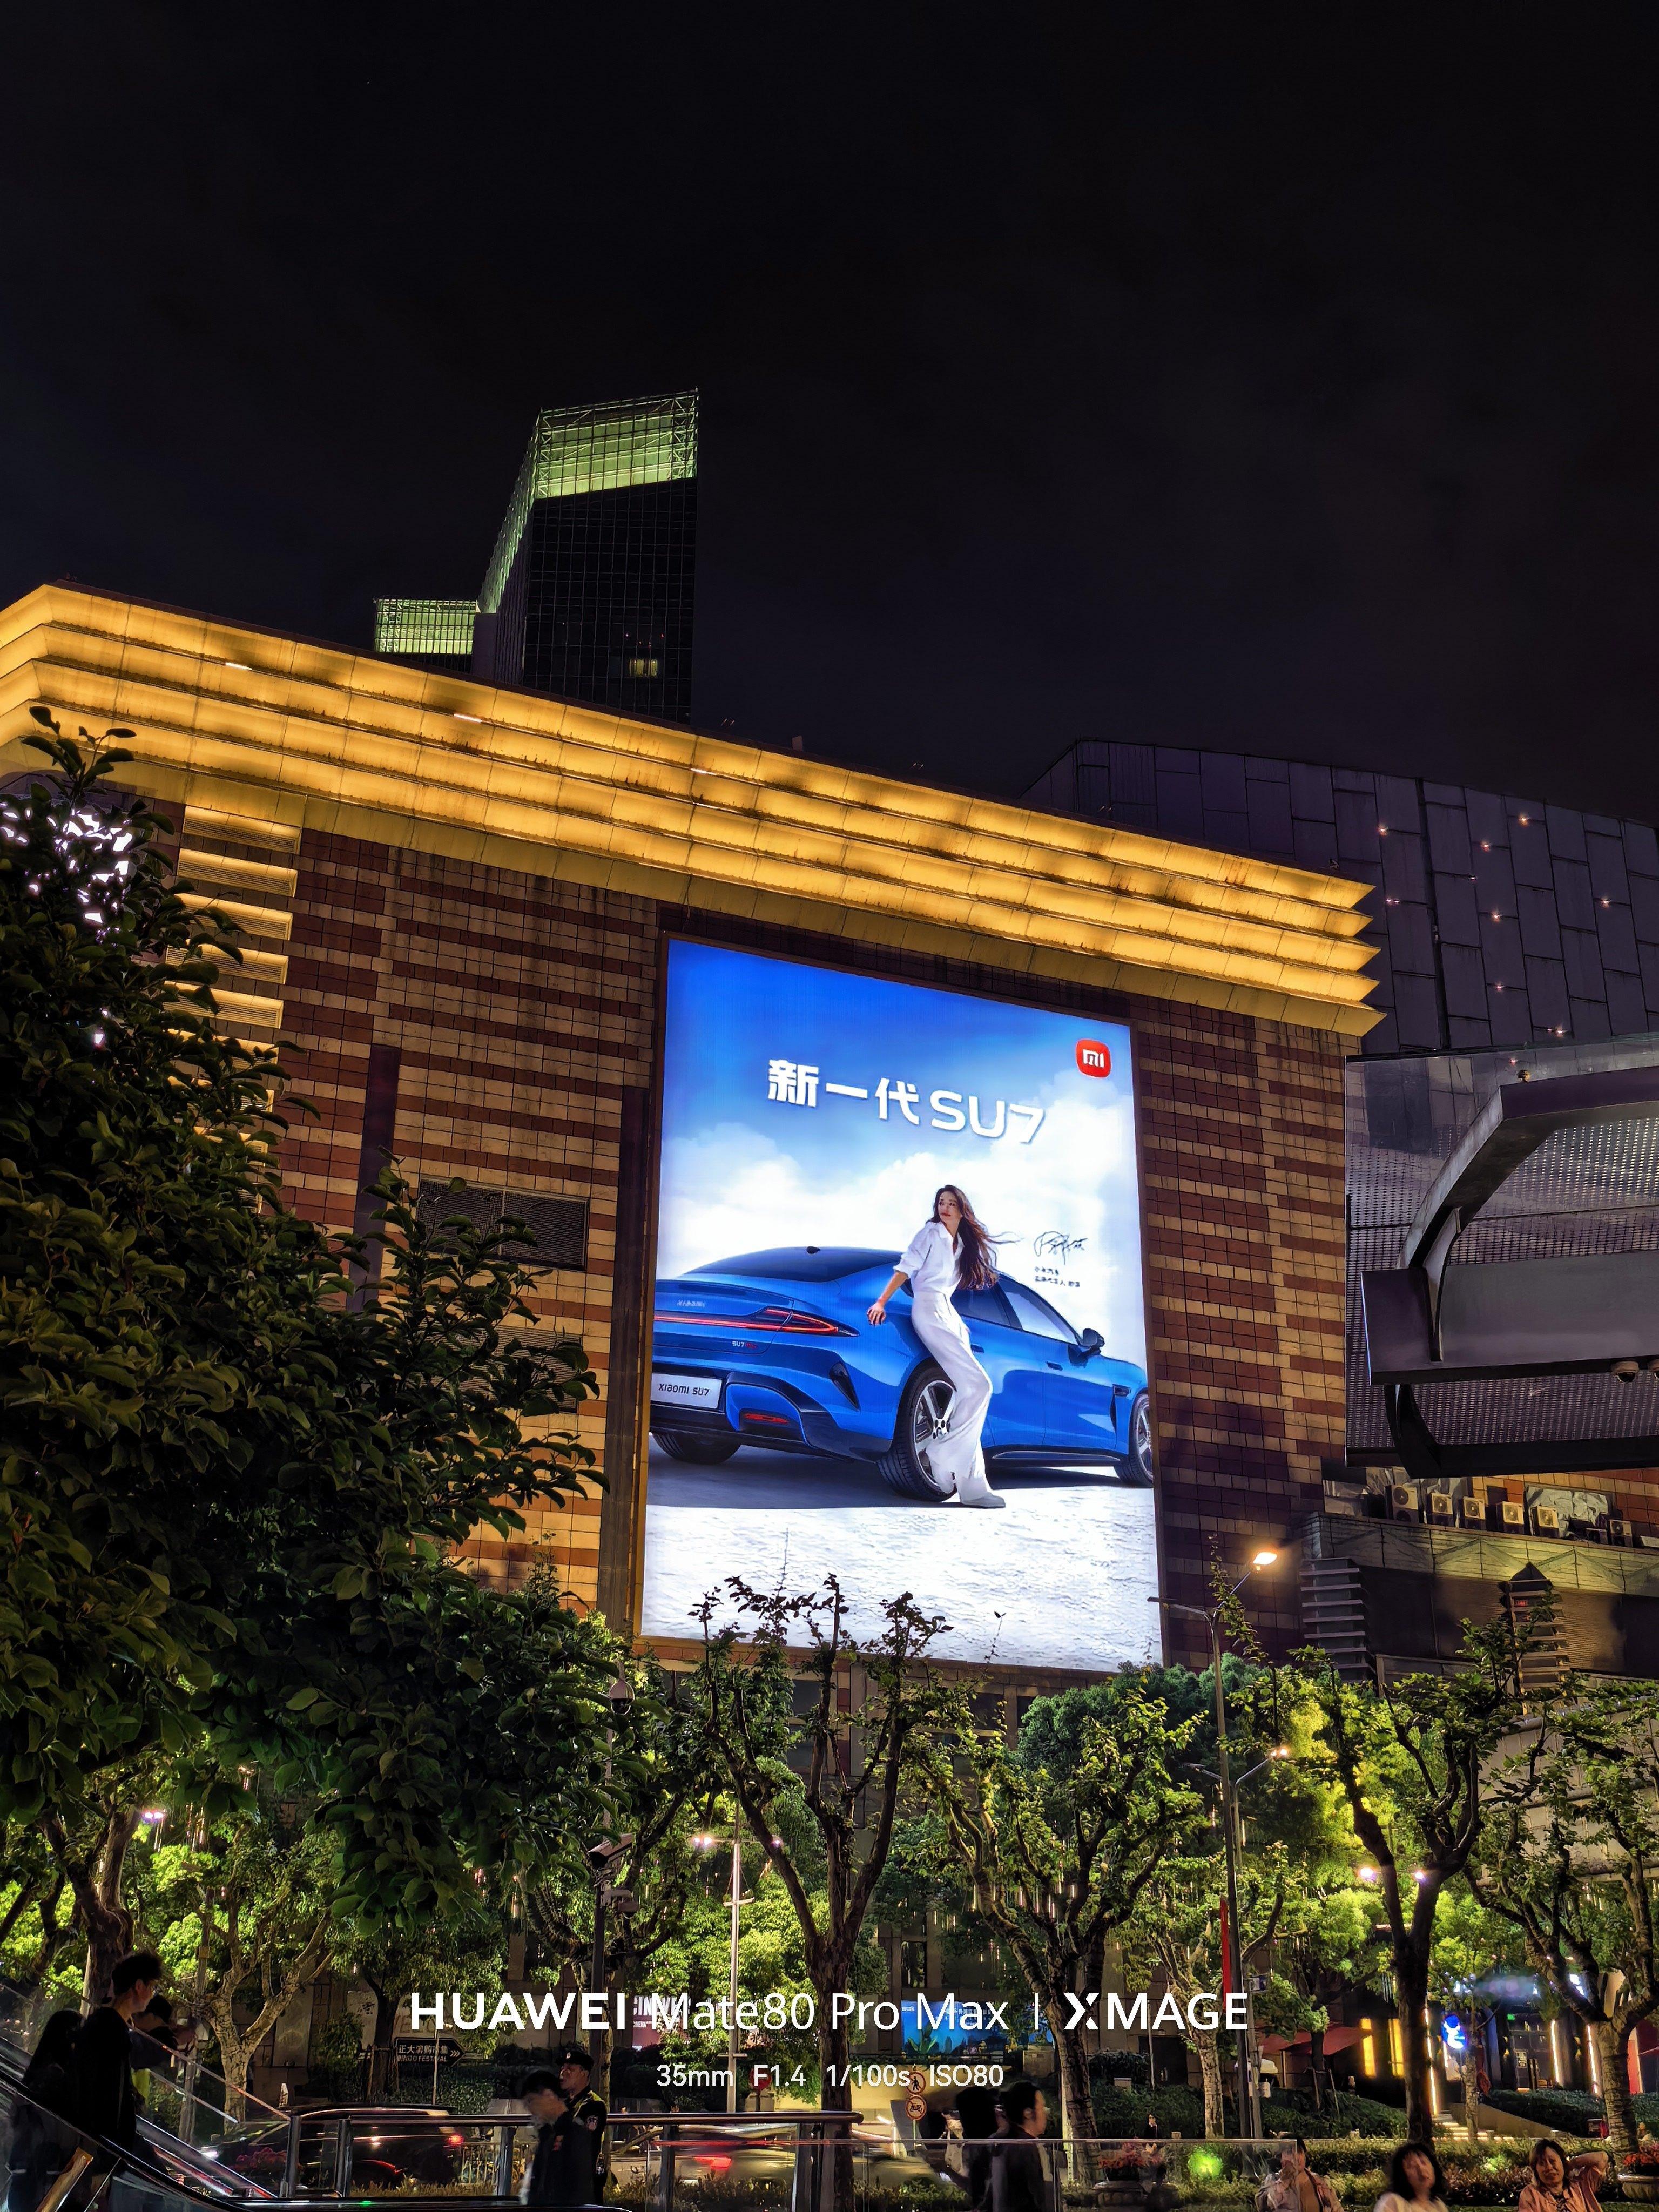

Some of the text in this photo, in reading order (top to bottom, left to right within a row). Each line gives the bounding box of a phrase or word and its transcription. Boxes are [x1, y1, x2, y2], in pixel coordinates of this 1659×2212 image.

[767, 1058, 1046, 1143] 新一代 SU7
[692, 1387, 710, 1397] SU7
